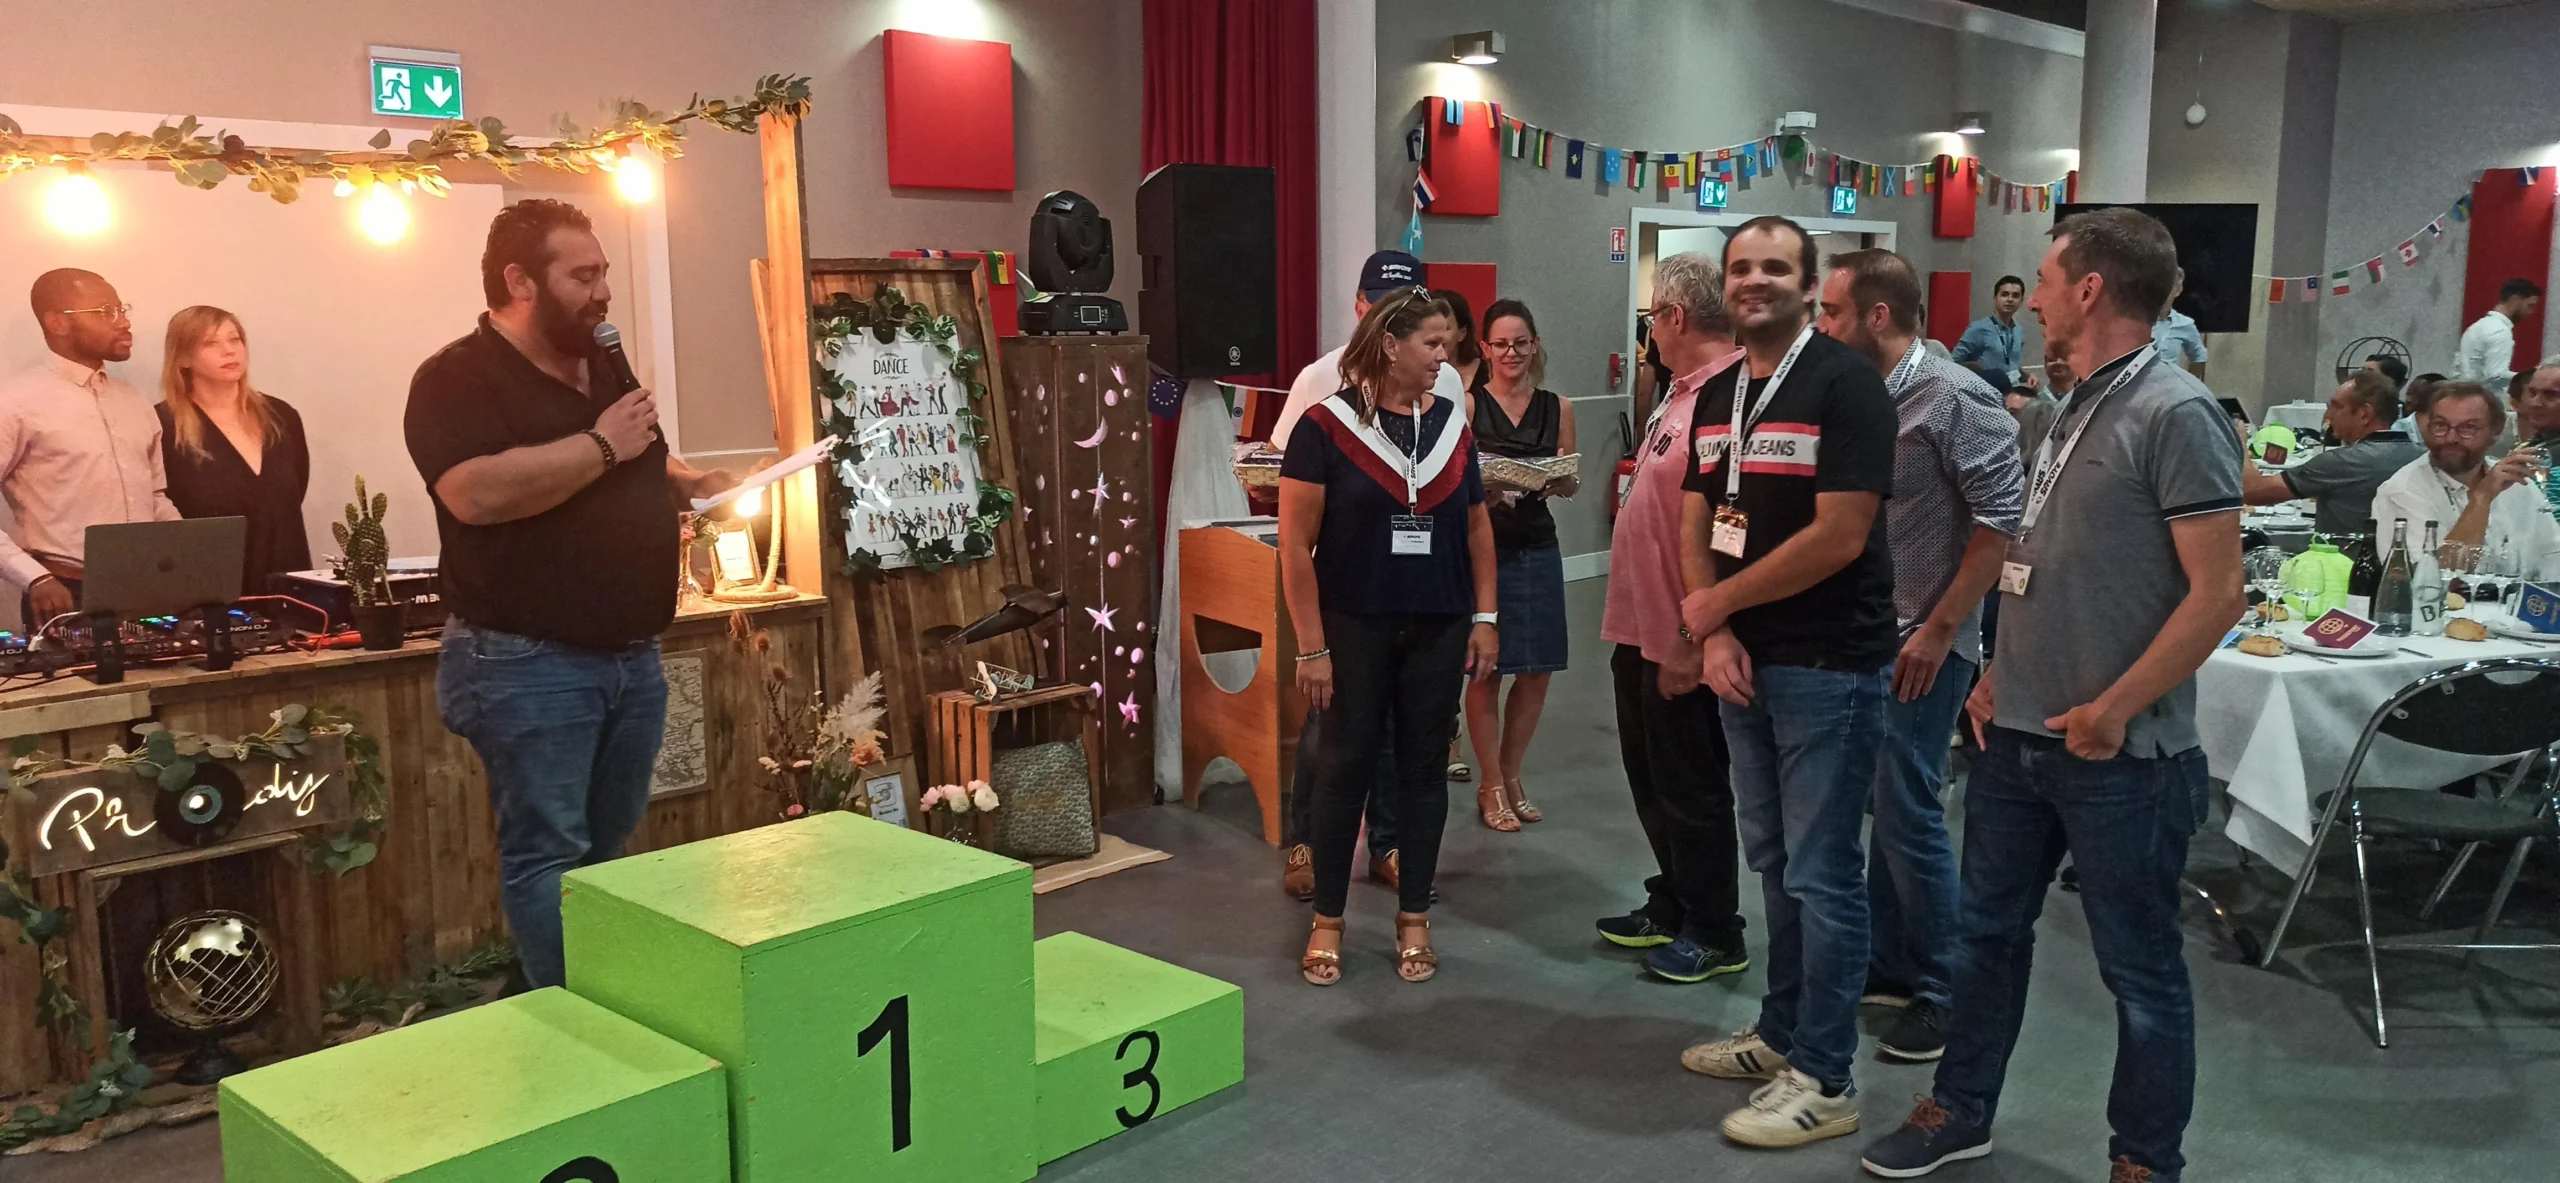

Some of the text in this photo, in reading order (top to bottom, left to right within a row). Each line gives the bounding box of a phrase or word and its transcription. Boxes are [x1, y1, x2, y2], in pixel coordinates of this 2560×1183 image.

[873, 358, 910, 375] DANCE
[2106, 370, 2132, 395] SAVO
[1752, 440, 1796, 456] JEANS
[2040, 461, 2062, 497] SAVOYE
[857, 994, 911, 1153] 1
[1115, 1030, 1160, 1129] 3
